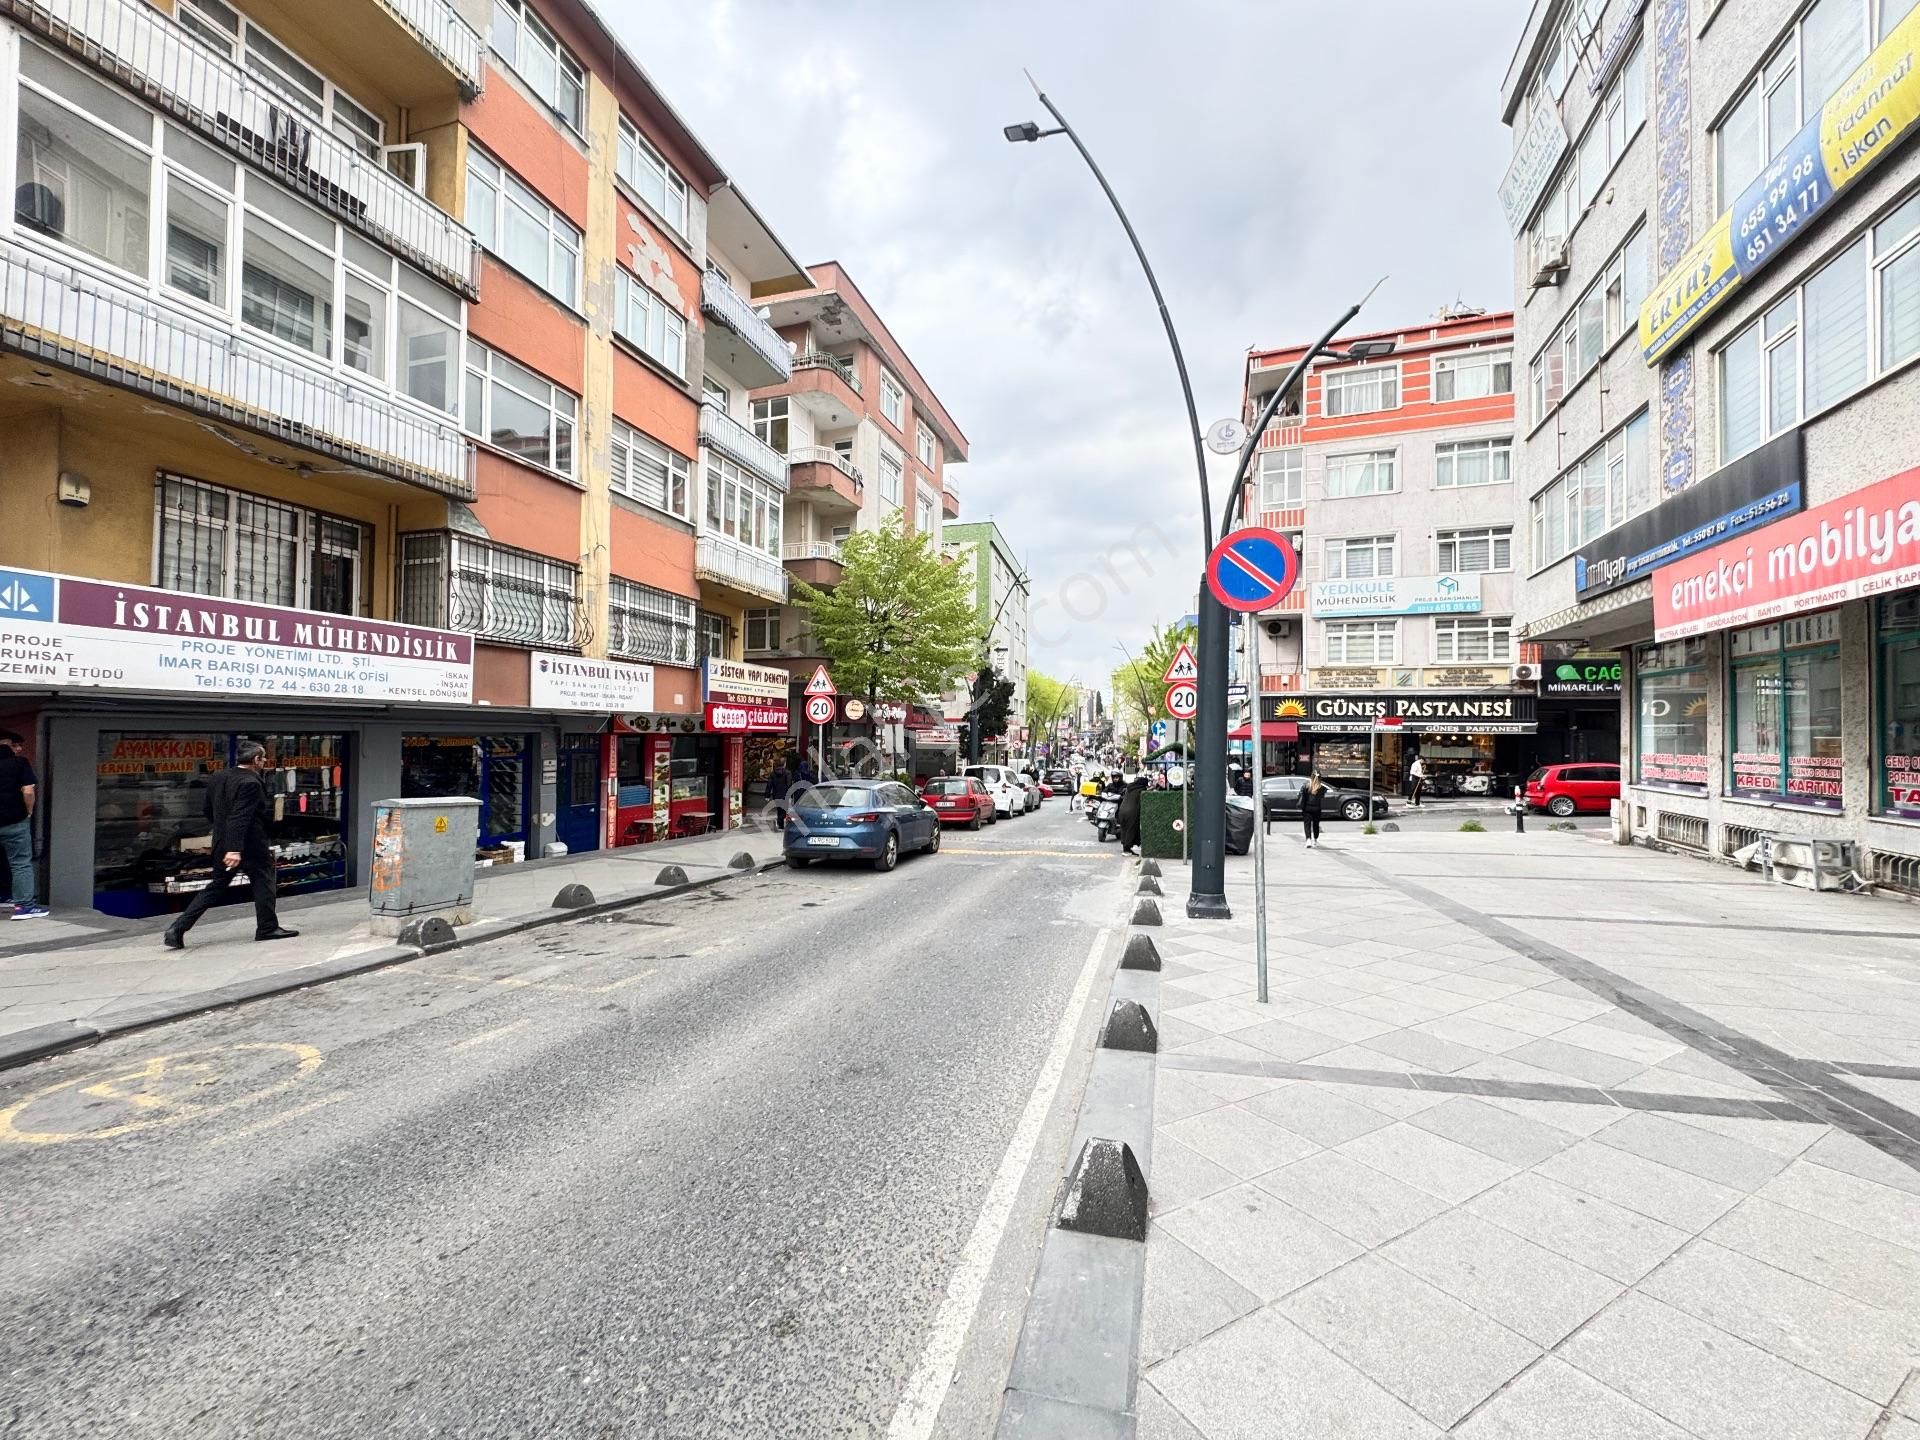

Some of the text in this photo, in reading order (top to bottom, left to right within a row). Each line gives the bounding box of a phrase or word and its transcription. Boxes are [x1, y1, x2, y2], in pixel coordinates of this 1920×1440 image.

[1740, 154, 1814, 238] 655 99 98
[1746, 180, 1820, 262] 651 34 77
[1671, 500, 1920, 611] emekçi mobilya
[1319, 581, 1394, 596] YEDİKULE
[1316, 594, 1396, 607] MÜHENDİSLİK
[1757, 604, 1782, 618] BANYO
[1793, 588, 1847, 610] PORTMANTO
[113, 592, 459, 661] İSTANBUL MÜHENDİSLİK
[1, 633, 64, 648] PROJE
[0, 648, 75, 663] RUHSAT
[181, 640, 376, 668] PROJE YÖNETİMİ LTD. ŞTİ.
[0, 663, 125, 680] ZEMİN ETÜDÜ
[159, 653, 389, 683] İMAR BARIŞI DANIŞMANLIK OFİSİ
[445, 671, 469, 680] İSKAN
[551, 658, 651, 684] İSTANBUL İNŞAAT
[720, 662, 789, 686] SİSTEM YAPI DENETİM
[195, 675, 364, 695] Tel: 630 72 44 630 28 18
[388, 687, 469, 698] KENTSEL DÖNÜŞÜM
[441, 680, 469, 689] İNŞAAT
[1547, 683, 1605, 692] MİMARLIK
[1174, 692, 1195, 708] 20
[1316, 698, 1512, 718] GÜNEŞ PASTANESİ
[812, 703, 829, 716] 20
[1310, 724, 1341, 732] GÜNEŞ
[1425, 725, 1459, 733] GÜNEŞ
[112, 740, 213, 760] AYAKKABI
[1885, 755, 1911, 771] GENÇ
[1737, 775, 1777, 790] KREDİ
